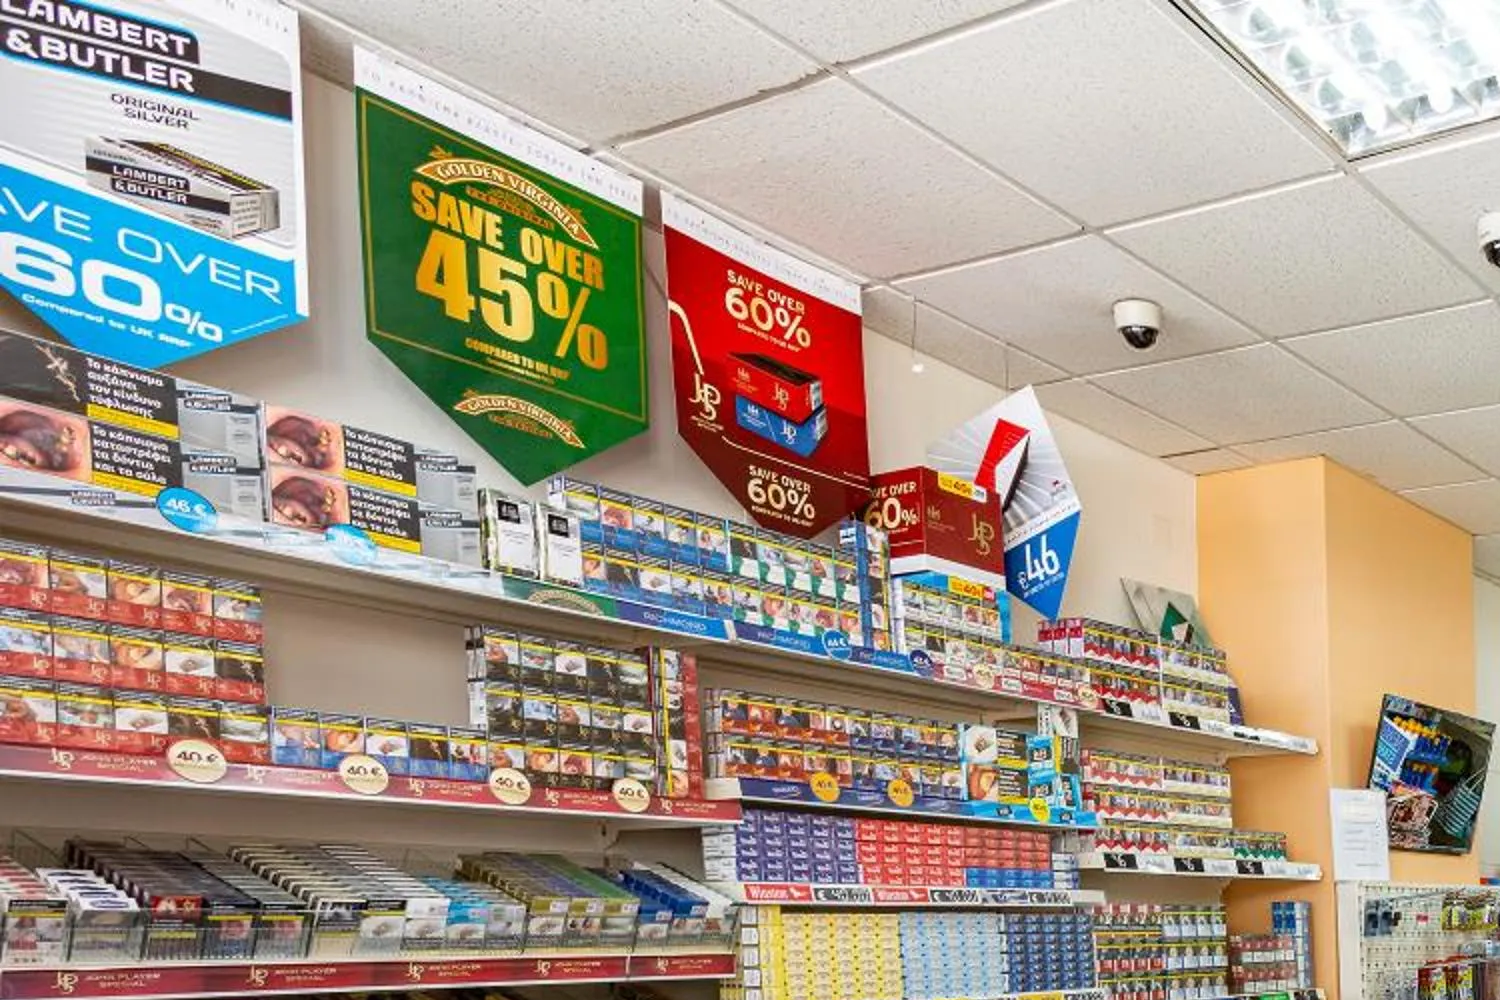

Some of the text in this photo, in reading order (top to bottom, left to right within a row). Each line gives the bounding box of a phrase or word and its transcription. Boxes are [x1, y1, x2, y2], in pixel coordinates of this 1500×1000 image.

[1, 0, 191, 56] LAMBERT
[111, 92, 201, 121] ORIGINAL
[123, 107, 189, 130] SILVER
[112, 165, 187, 190] LAMBERT
[435, 161, 505, 185] GOLDEN
[508, 177, 582, 236] VIRGINIA
[411, 180, 505, 251] SAVE
[519, 227, 605, 291] OVER
[117, 227, 283, 305] OVER
[0, 231, 223, 343] 60%
[415, 229, 609, 370] 45%
[726, 268, 806, 315] SAVE OVER
[724, 286, 811, 349] 60%
[103, 362, 163, 388] κάπνισμα
[112, 387, 162, 410] κίνδυνο
[468, 396, 518, 413] GOLDEN
[109, 429, 169, 452] κάπνισμα
[748, 464, 812, 496] SAVE OVER
[889, 480, 917, 495] OVER
[747, 482, 817, 519] 60%
